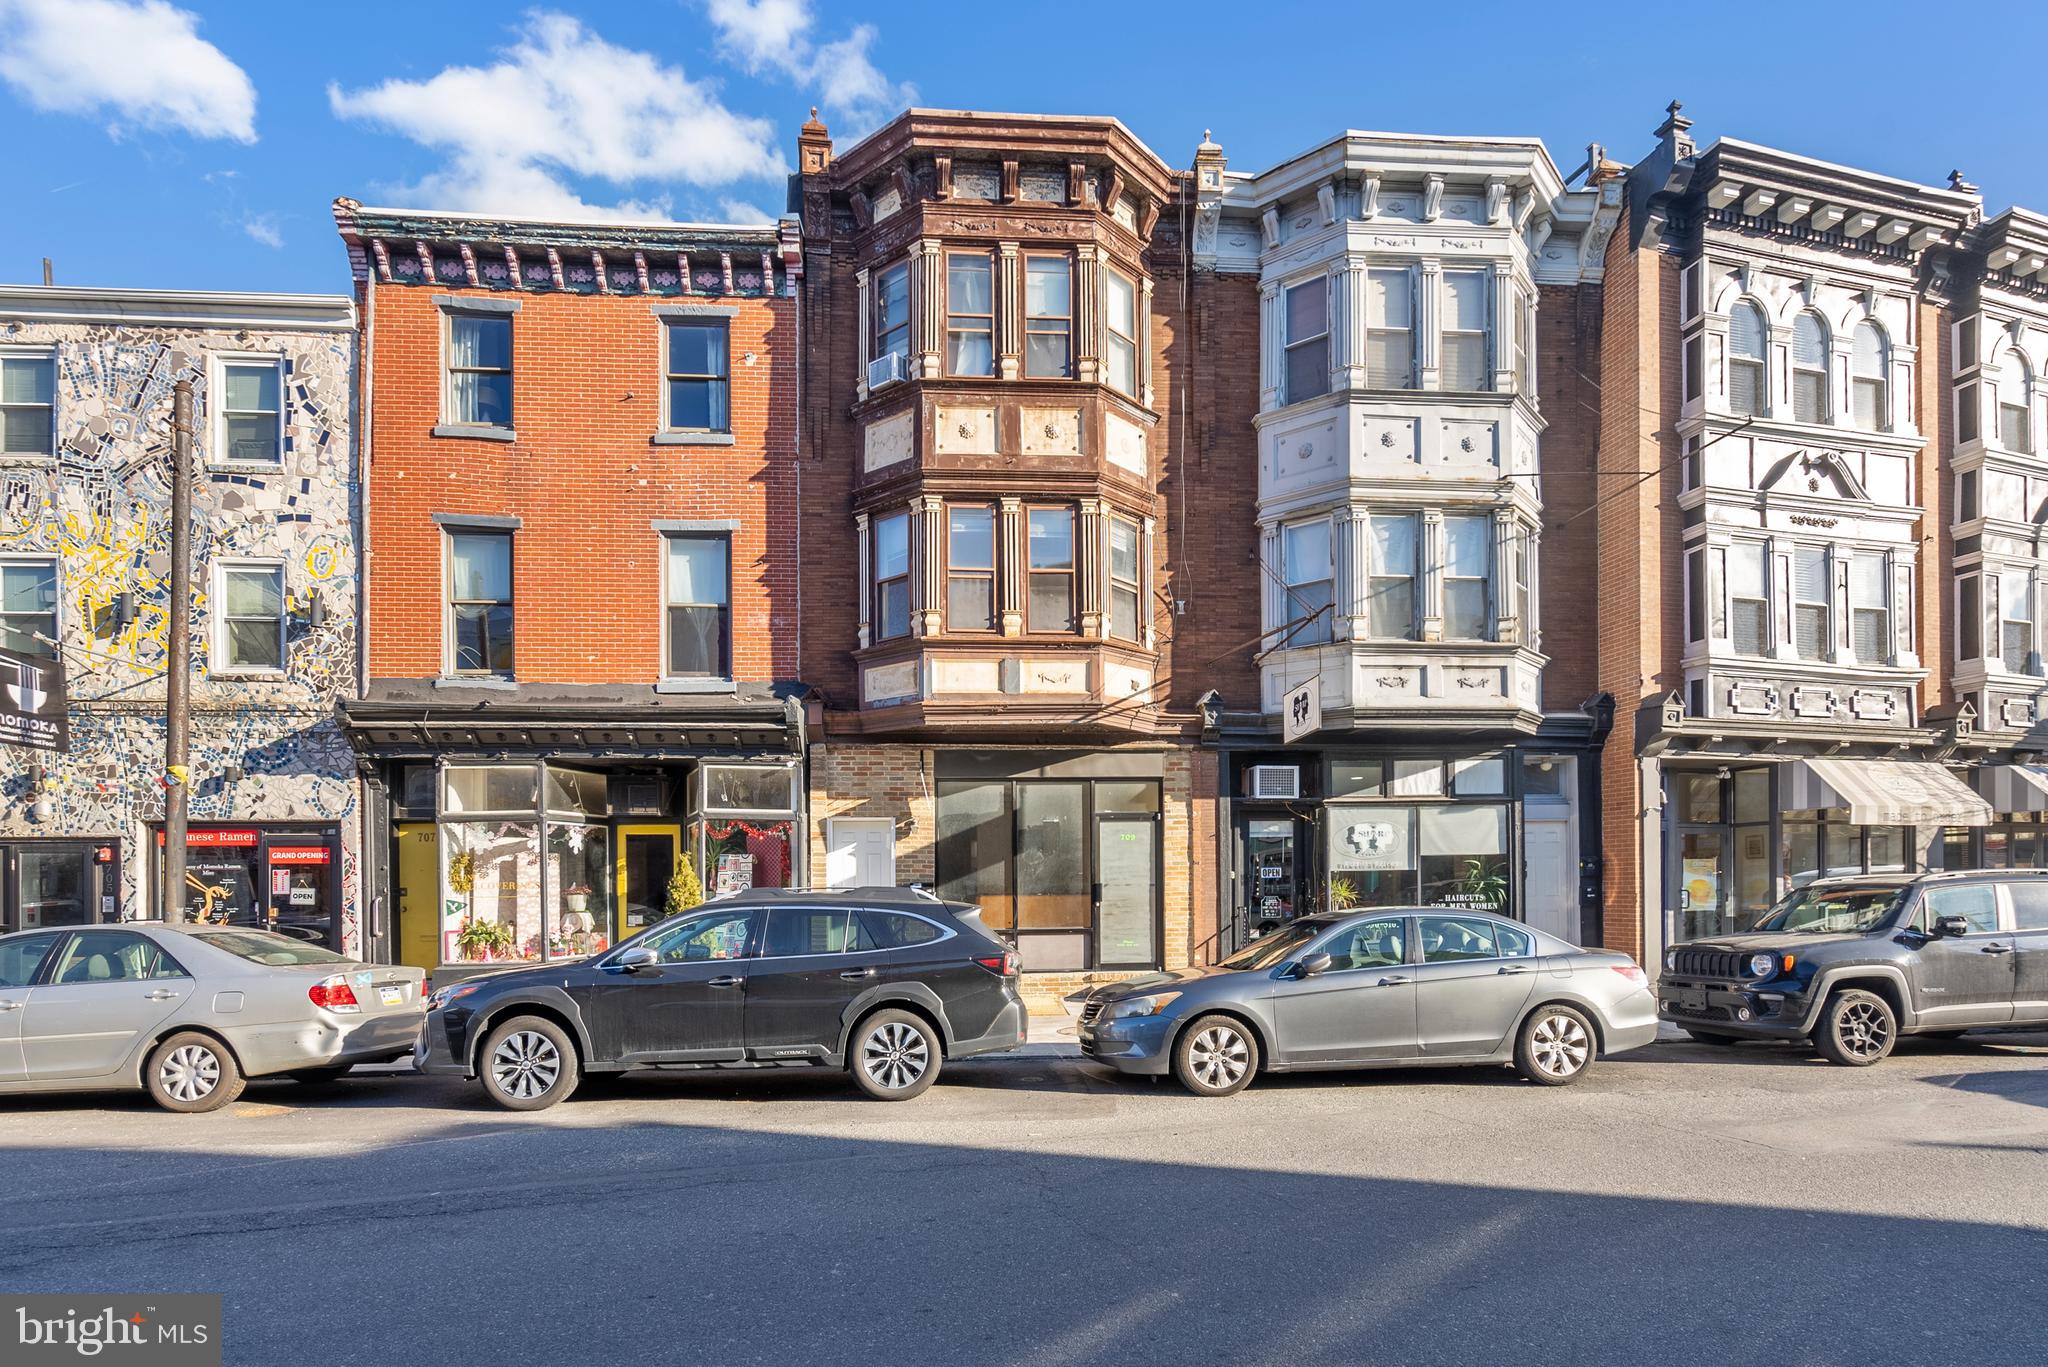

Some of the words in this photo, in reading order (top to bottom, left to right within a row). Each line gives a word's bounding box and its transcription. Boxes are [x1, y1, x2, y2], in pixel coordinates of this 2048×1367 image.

[219, 832, 257, 841] Ramen
[417, 832, 436, 842] 707
[1120, 833, 1136, 841] 709
[1262, 868, 1280, 877] OPEN
[105, 863, 113, 893] 705
[1444, 894, 1484, 902] HAIRCUTS
[1469, 902, 1498, 910] WOMEN
